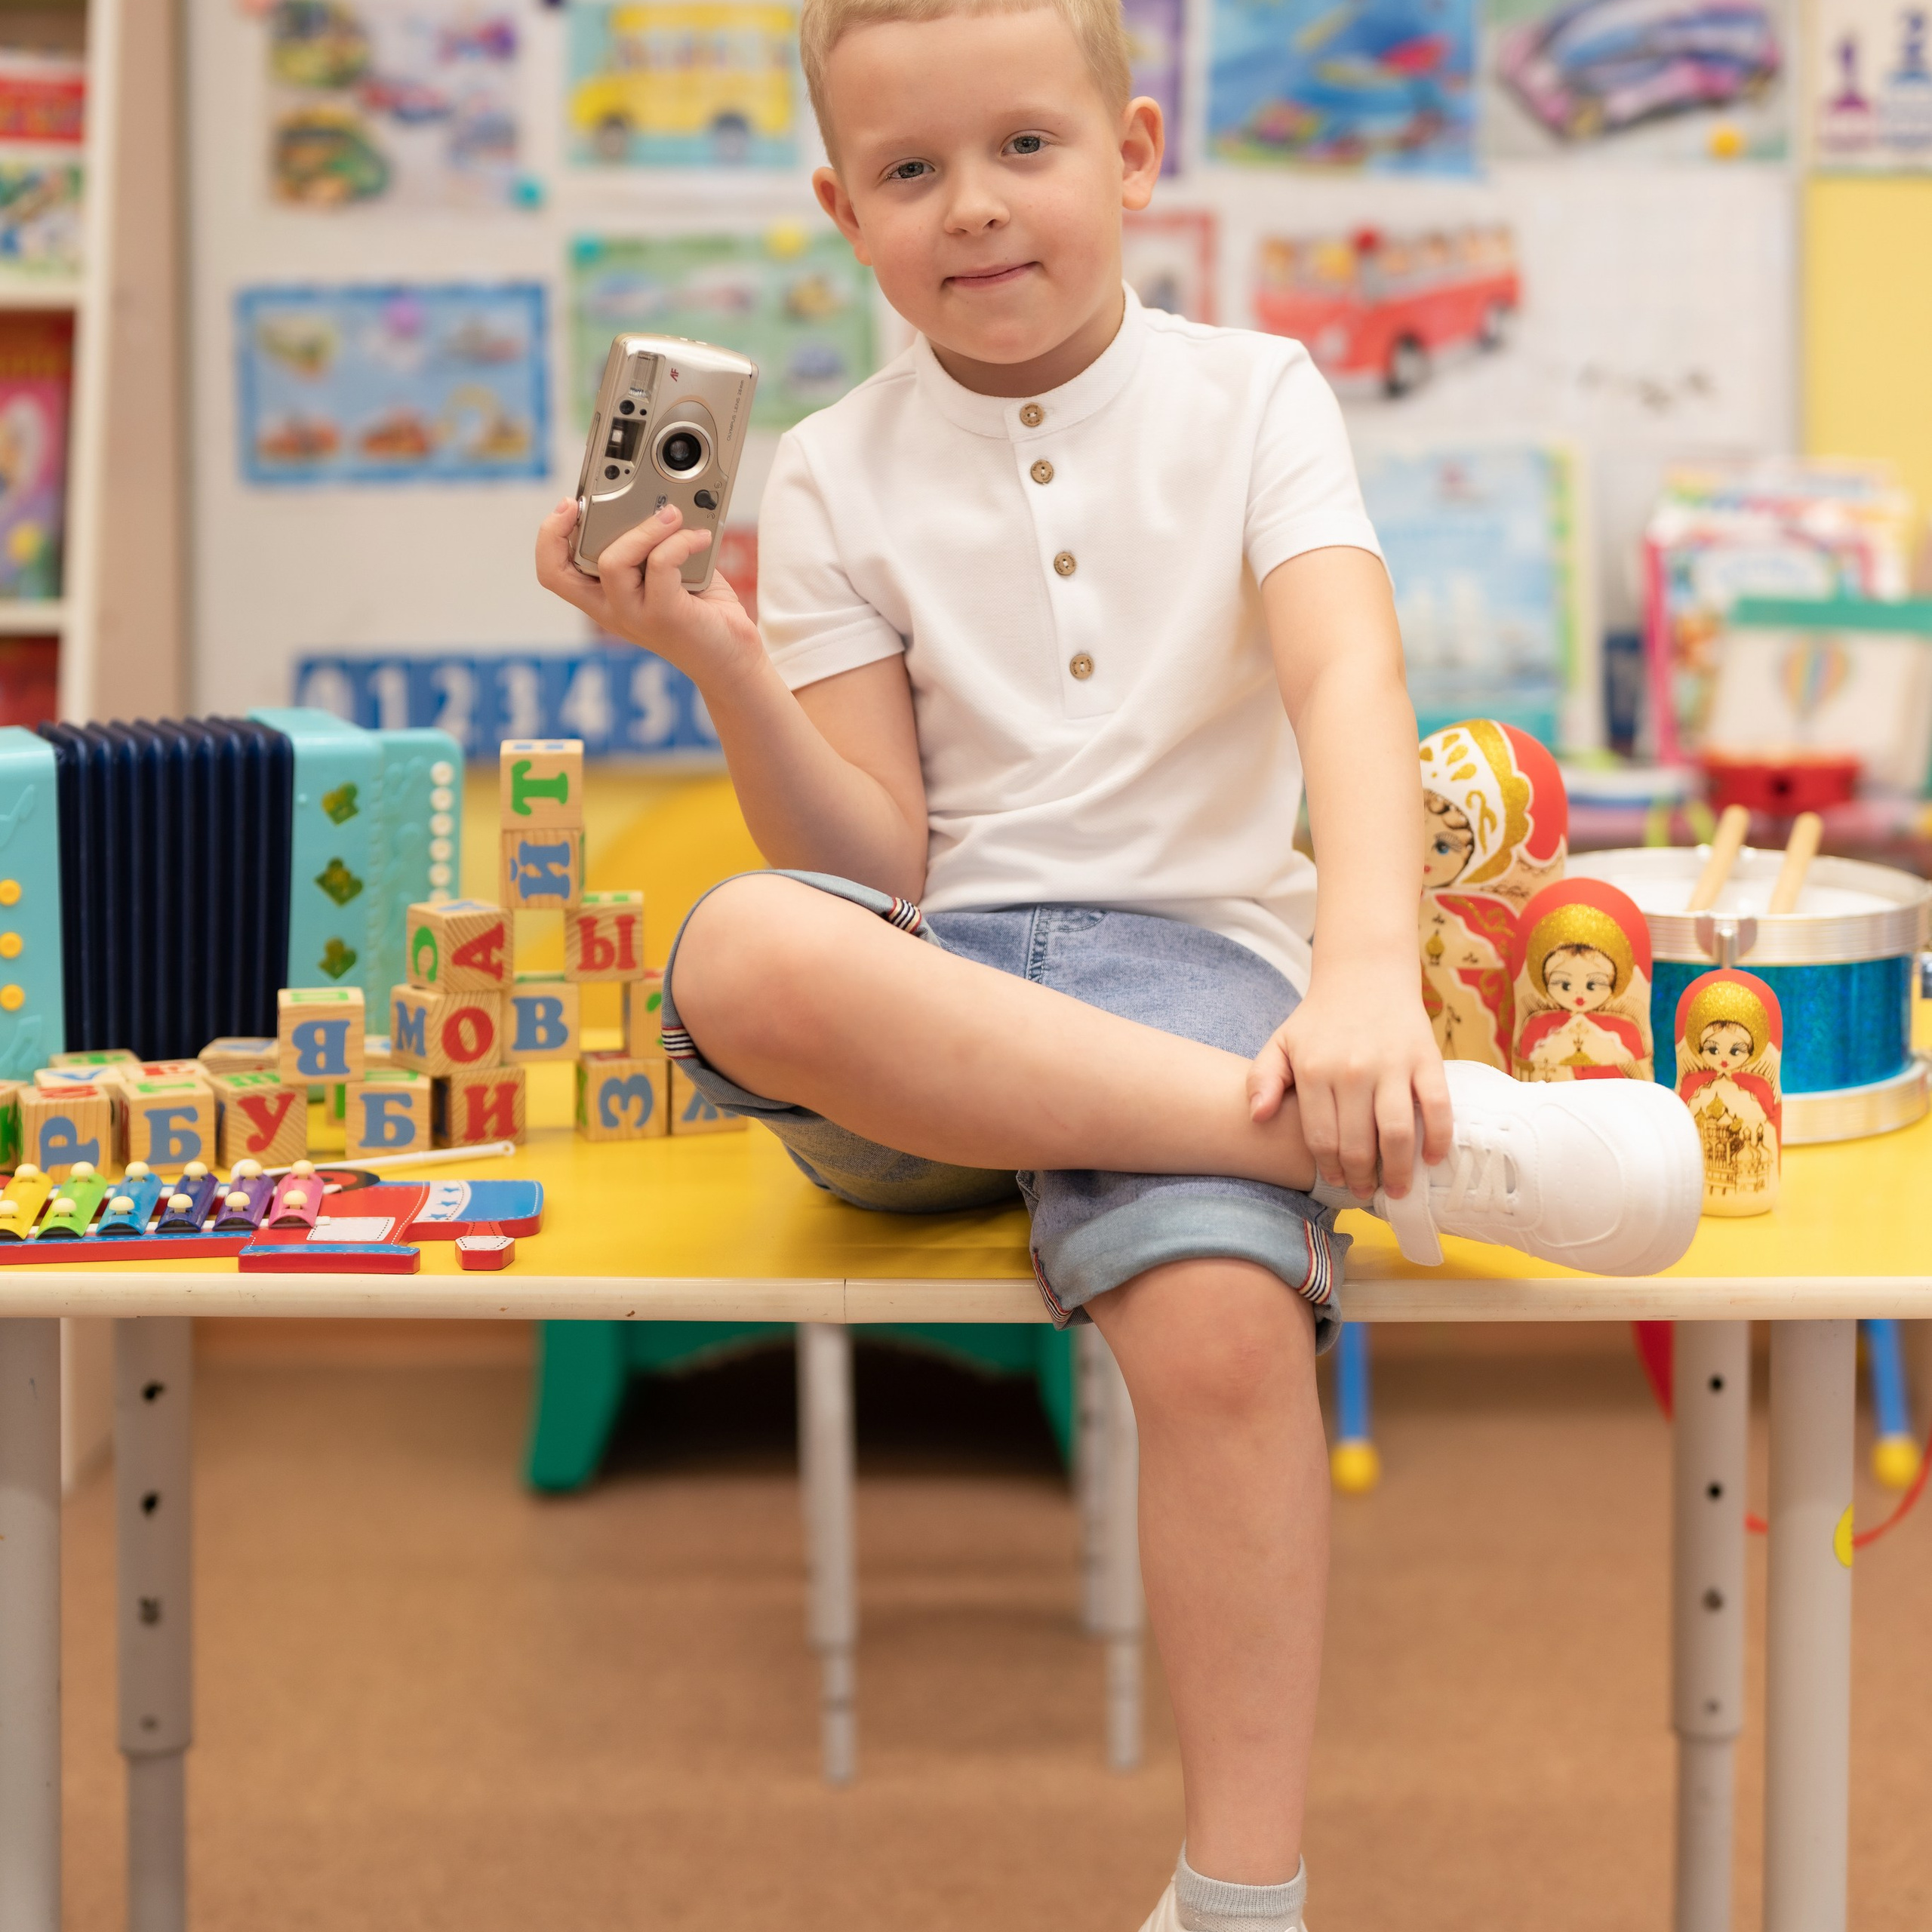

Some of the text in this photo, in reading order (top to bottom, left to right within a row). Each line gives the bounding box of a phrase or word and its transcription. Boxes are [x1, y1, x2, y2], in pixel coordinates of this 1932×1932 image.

[669, 368, 679, 382] AF
[726, 414, 737, 441] OLYMPUS
[733, 397, 741, 413] LENS
[560, 664, 613, 740] 4
[629, 660, 675, 744] 5
[511, 759, 568, 816] Т
[577, 914, 637, 971] Ы
[441, 1006, 494, 1063] О
[511, 995, 569, 1051] В
[143, 1106, 202, 1165] Б
[358, 1092, 415, 1148] Б
[463, 1081, 518, 1141] И
